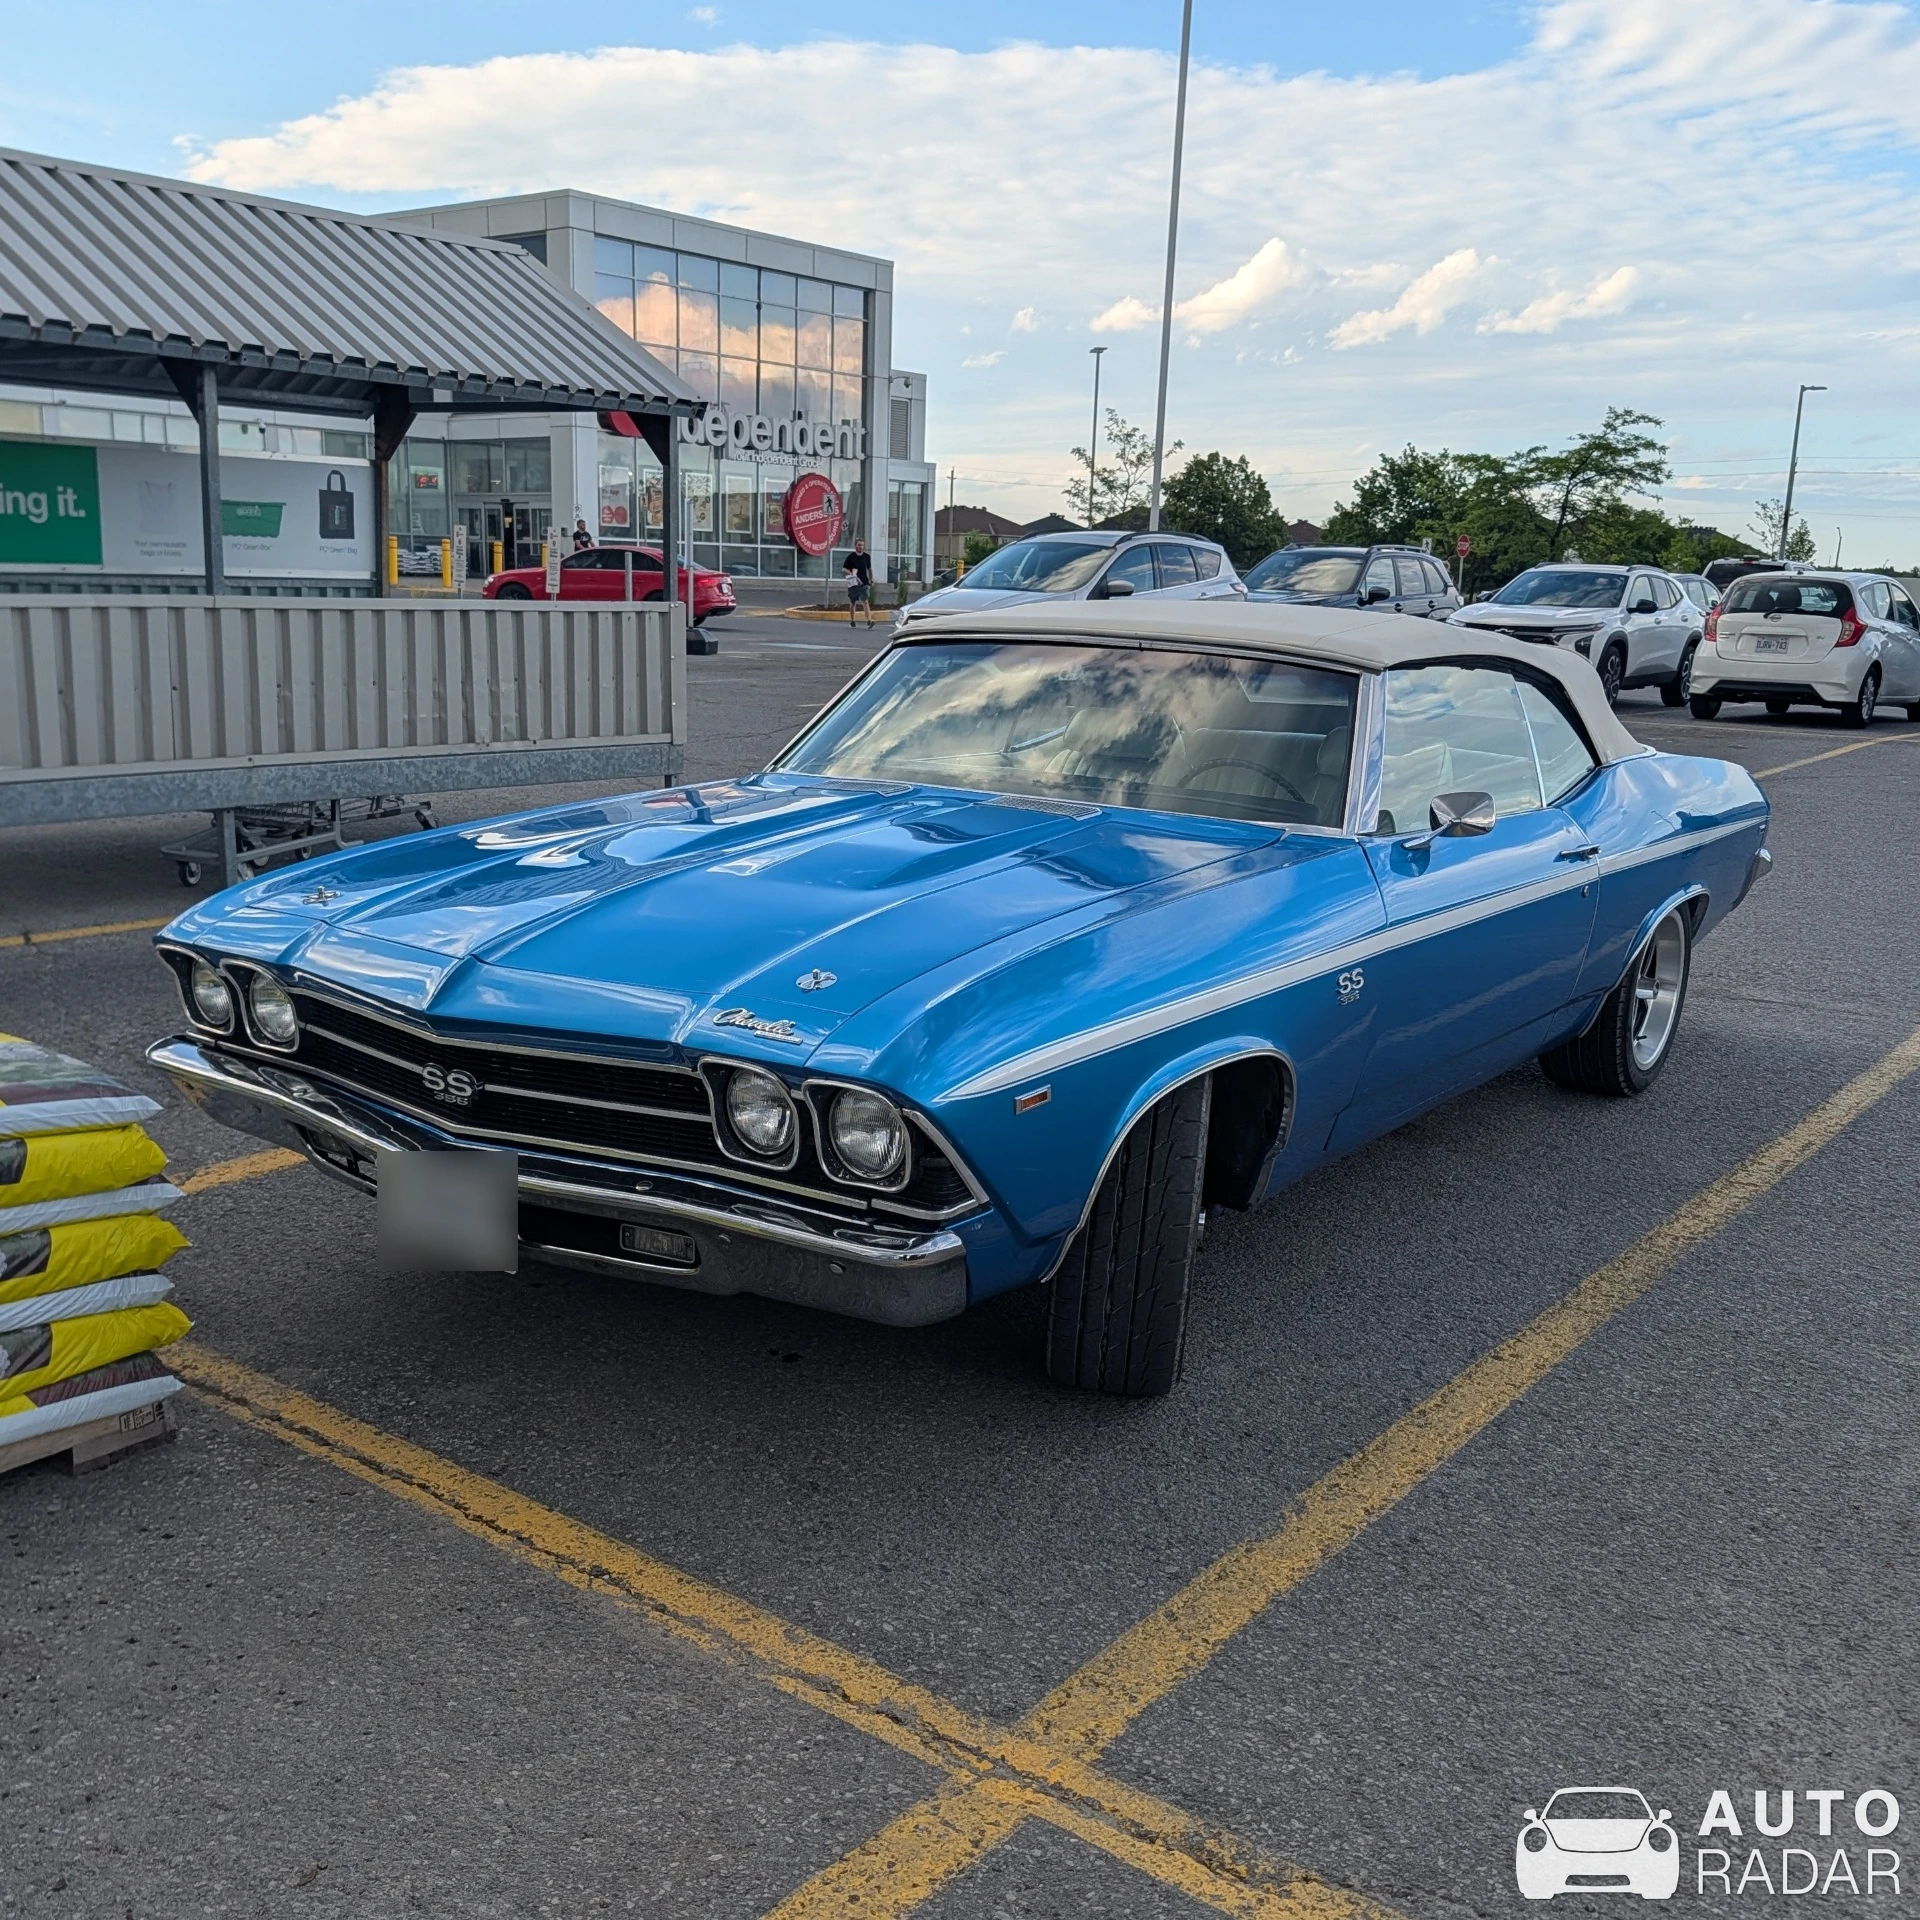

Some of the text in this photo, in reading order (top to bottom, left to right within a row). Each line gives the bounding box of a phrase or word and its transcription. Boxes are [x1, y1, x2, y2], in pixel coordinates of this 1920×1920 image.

[677, 409, 868, 461] dependent
[56, 485, 87, 518] it.
[798, 520, 840, 551] YOUR NEIGHOURS
[1338, 967, 1365, 994] SS
[422, 1065, 473, 1097] SS
